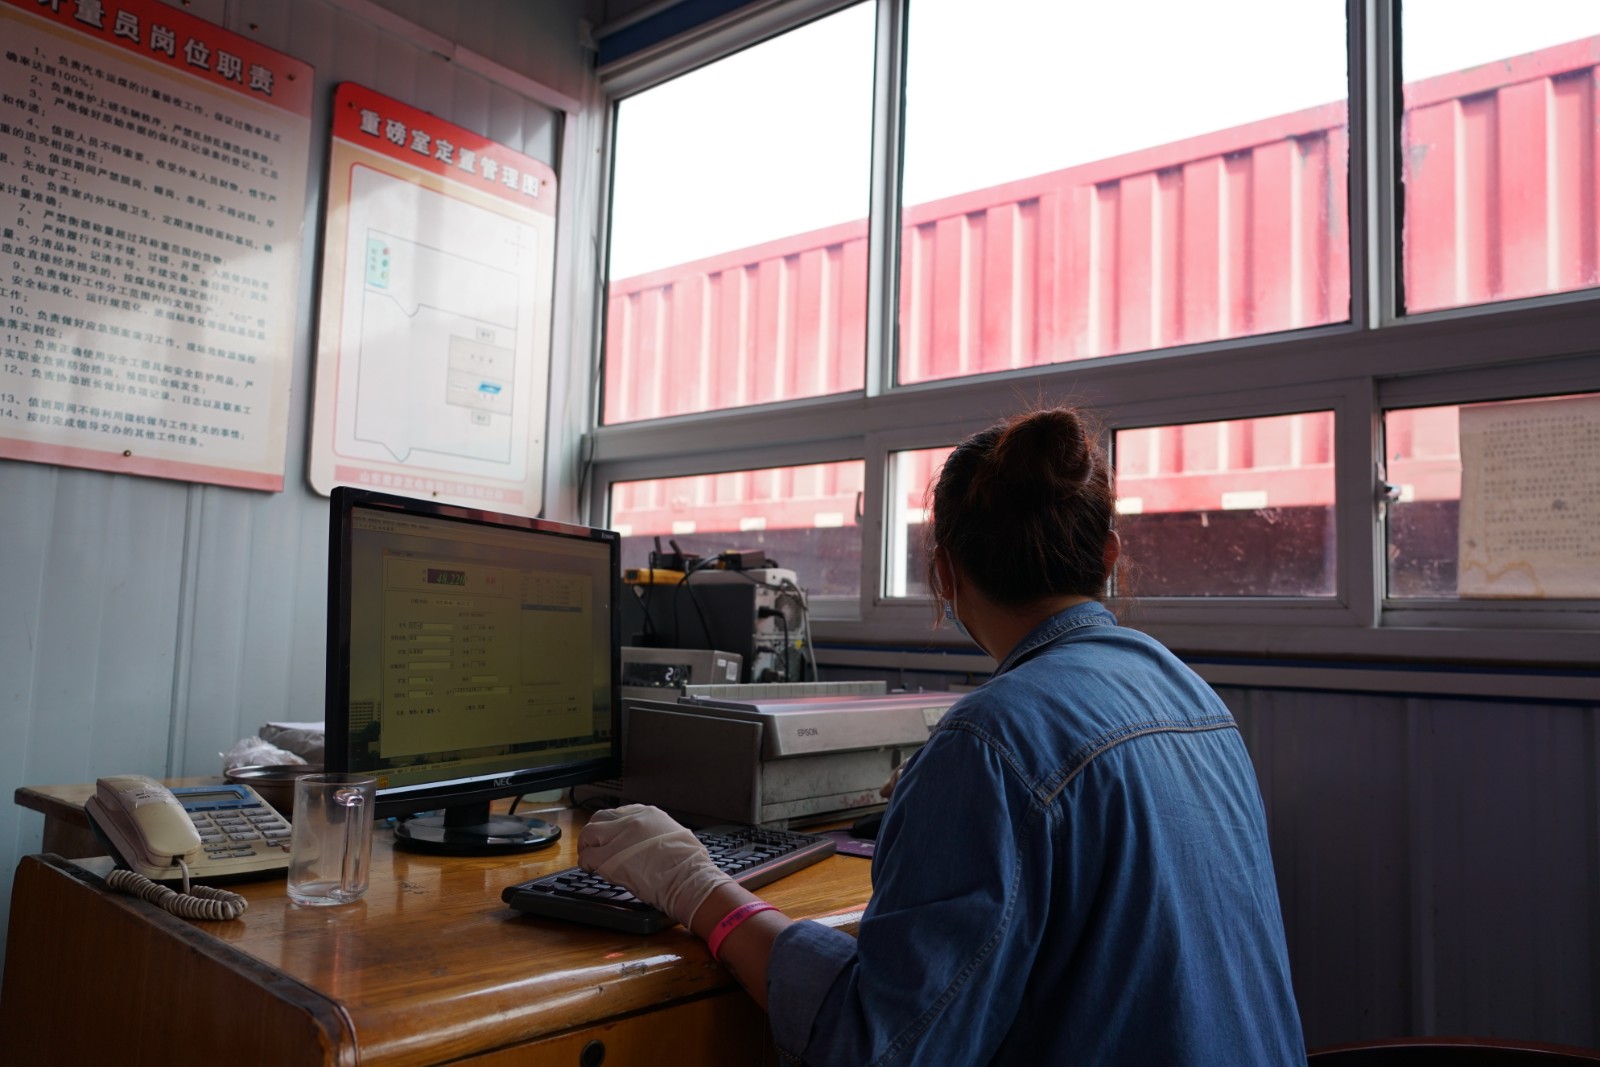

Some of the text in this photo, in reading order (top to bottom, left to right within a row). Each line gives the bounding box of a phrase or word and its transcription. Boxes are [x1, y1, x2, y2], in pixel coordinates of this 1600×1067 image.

[359, 108, 539, 198] 重磅室定置管理图
[797, 728, 818, 736] EPSON
[493, 777, 513, 788] NEC
